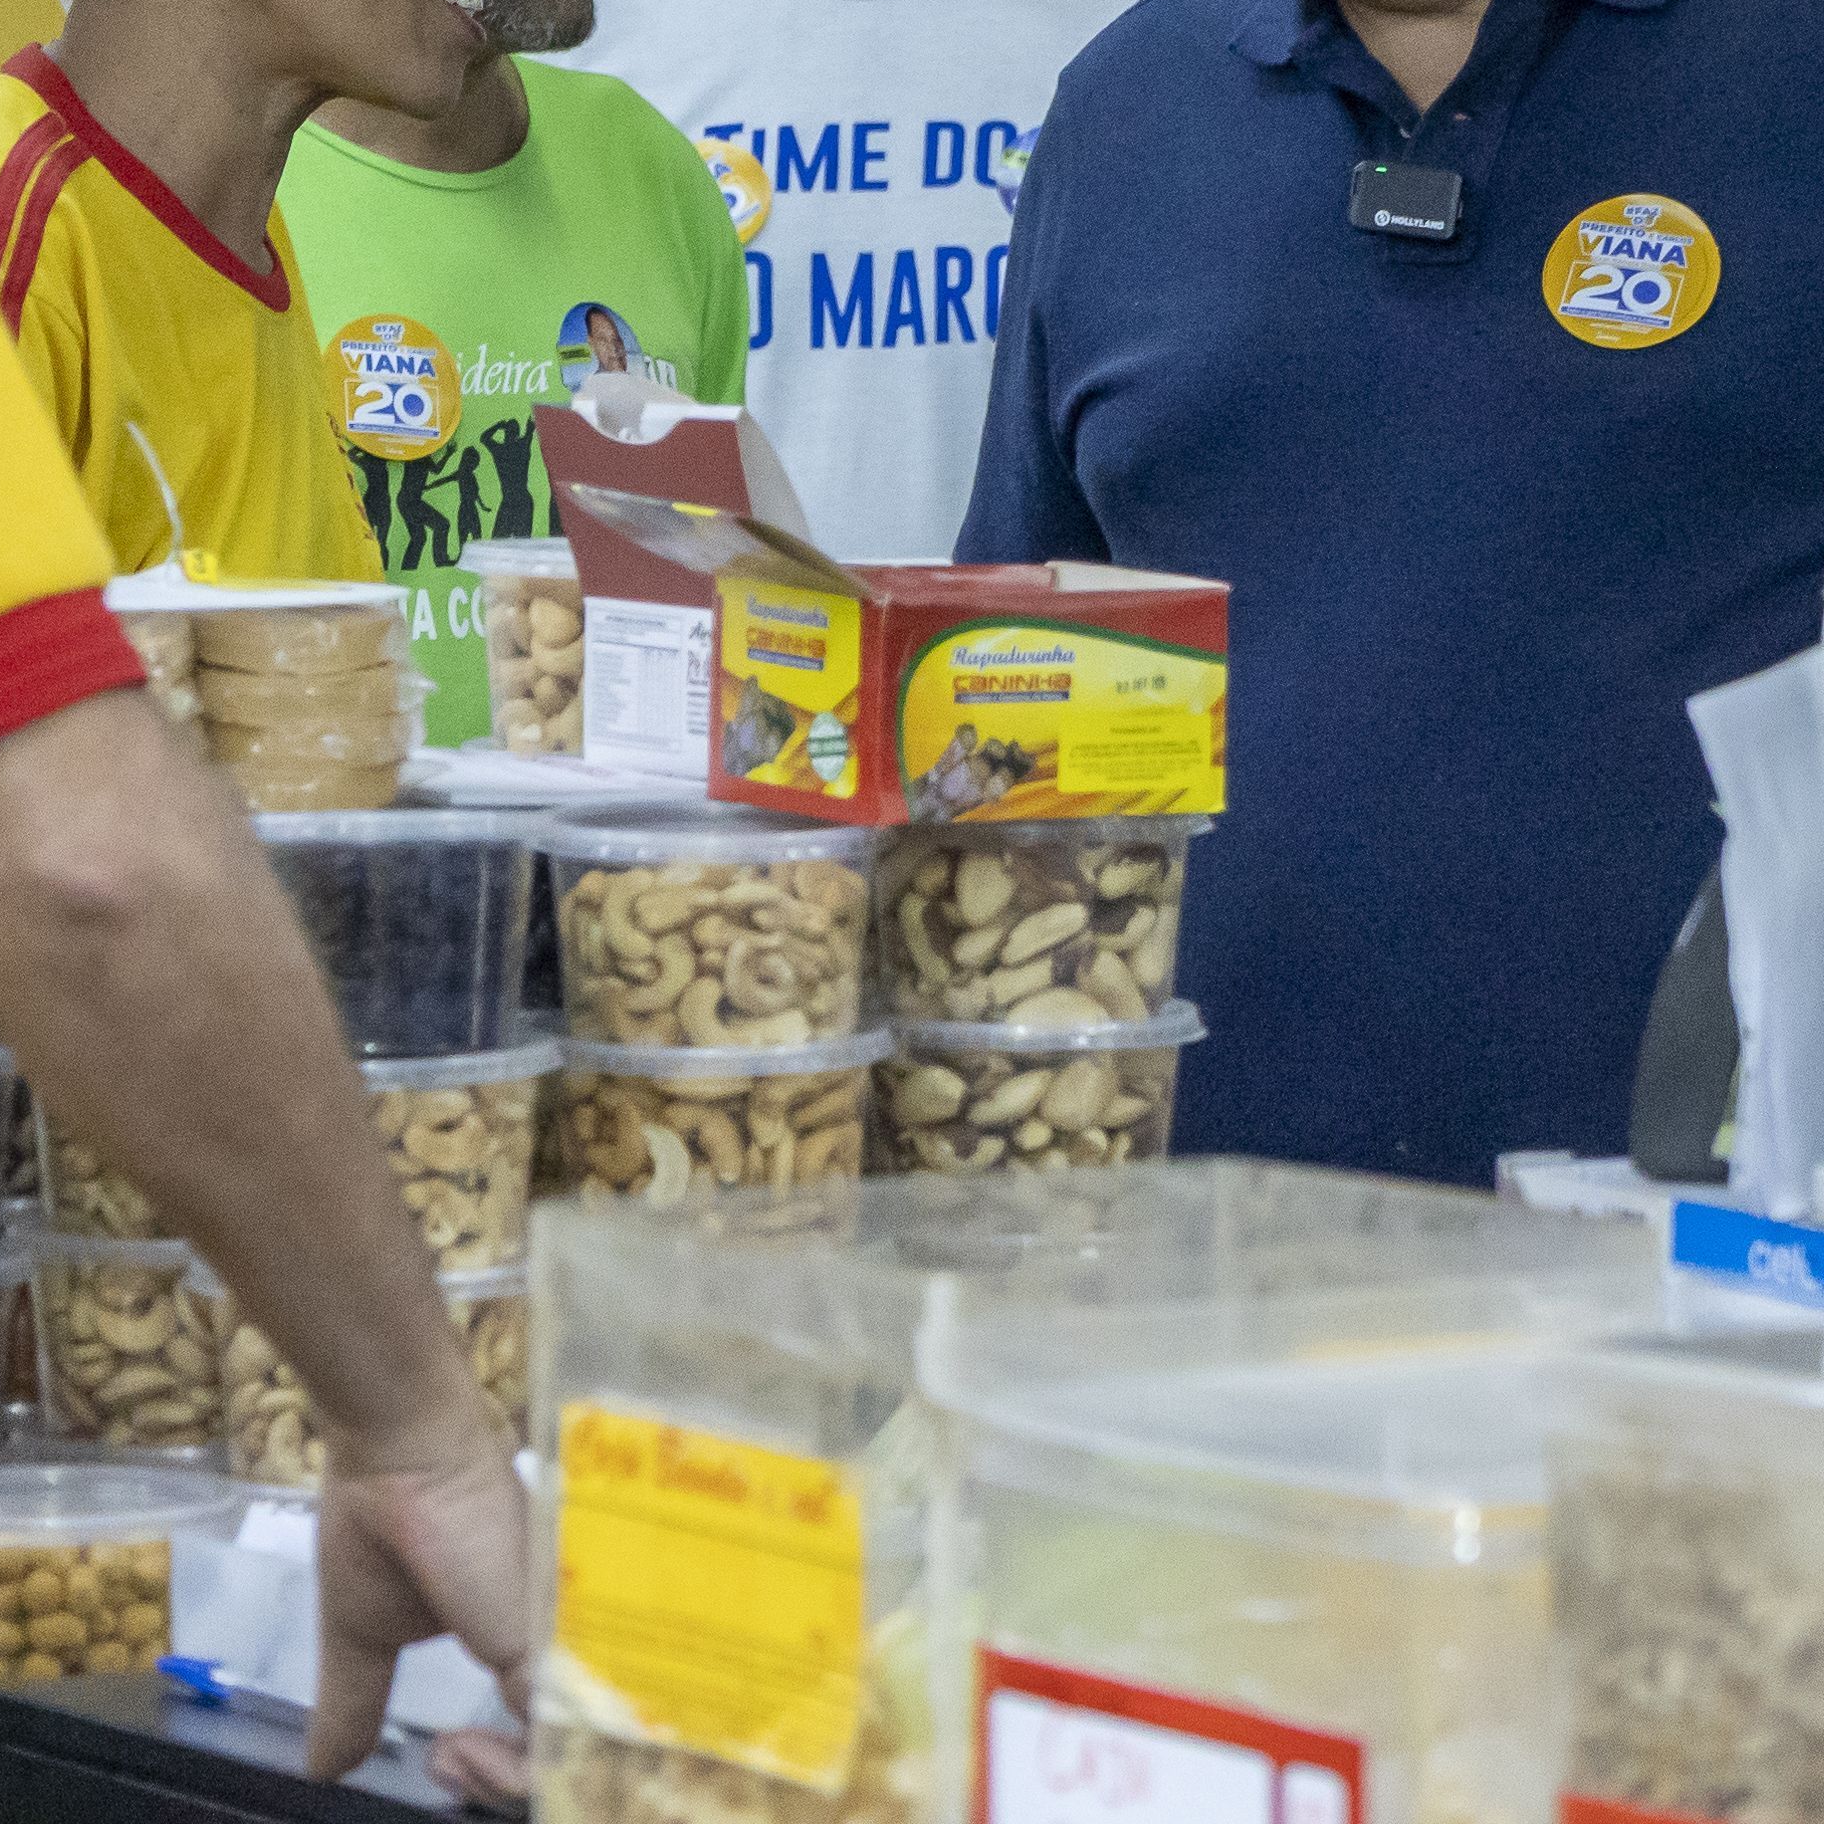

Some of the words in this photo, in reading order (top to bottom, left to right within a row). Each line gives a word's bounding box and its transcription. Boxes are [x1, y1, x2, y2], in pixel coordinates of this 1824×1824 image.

[1391, 214, 1446, 232] HOLLYLAND
[1580, 221, 1646, 238] PREFEITO
[1580, 233, 1687, 268] VIANA
[1569, 263, 1673, 315] 20
[341, 340, 398, 353] PREFEITO
[344, 352, 437, 378] VIANA
[352, 381, 435, 426] 20
[950, 644, 1077, 669] Rapadurinha
